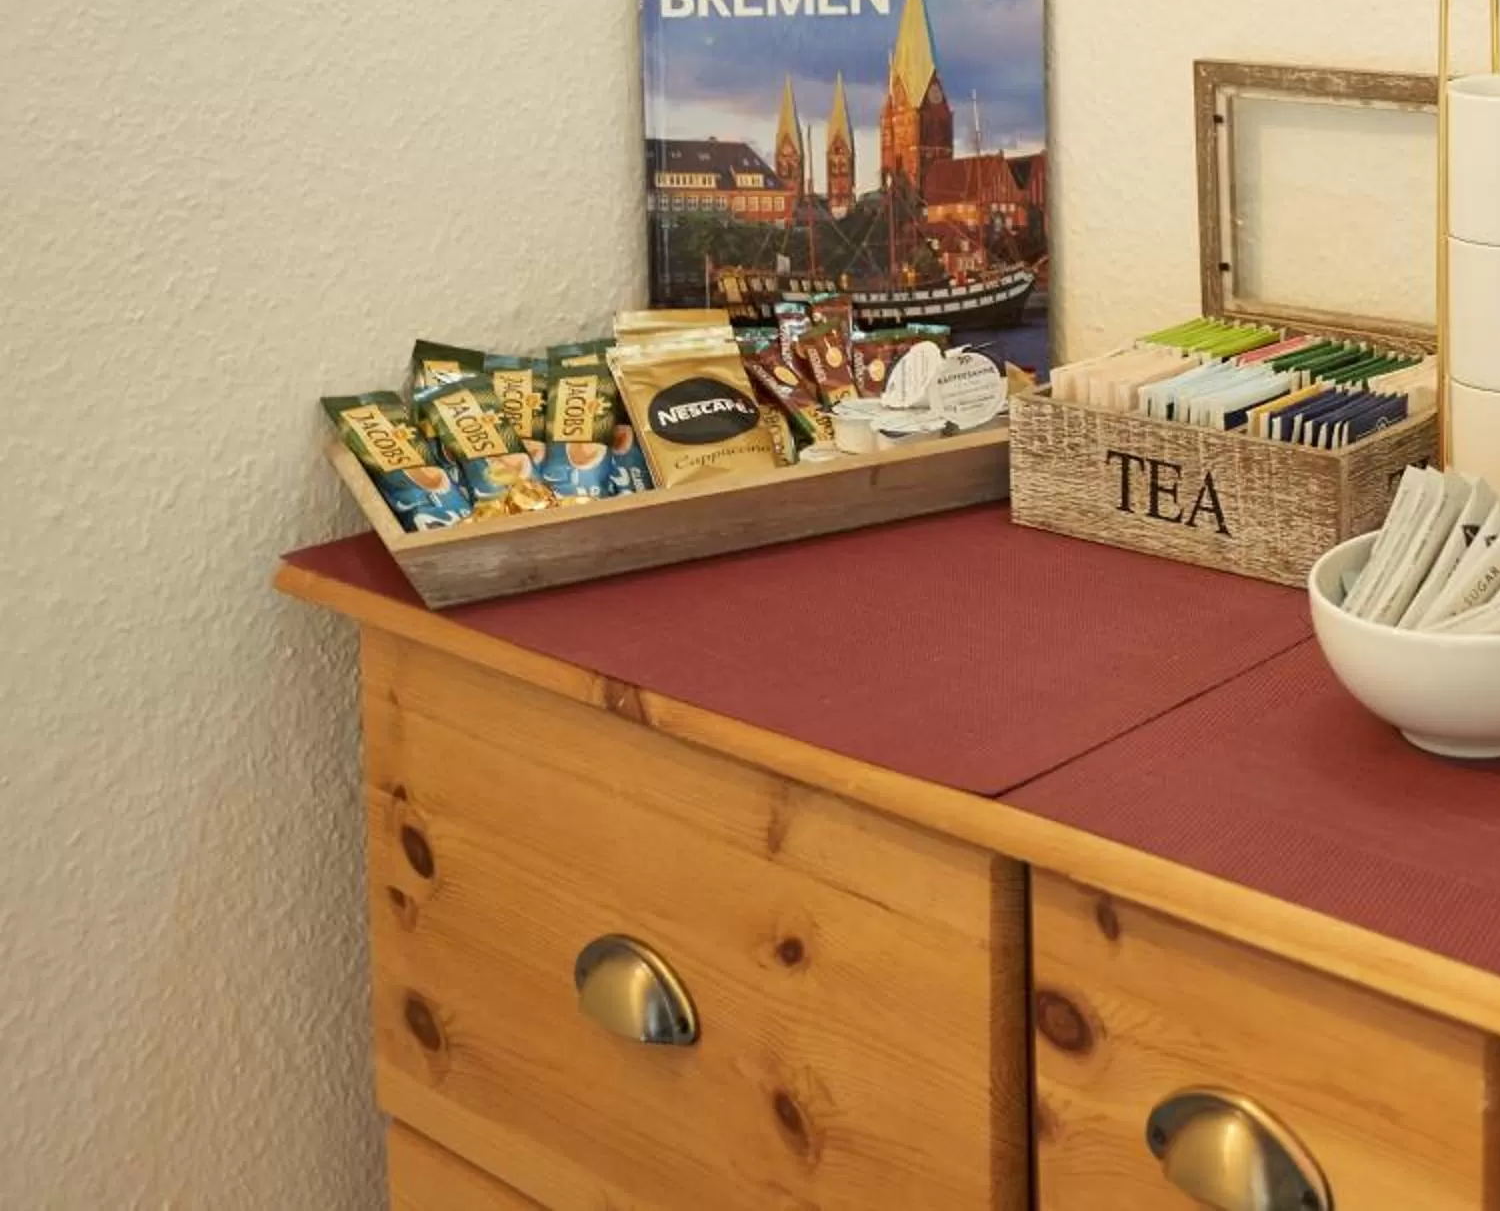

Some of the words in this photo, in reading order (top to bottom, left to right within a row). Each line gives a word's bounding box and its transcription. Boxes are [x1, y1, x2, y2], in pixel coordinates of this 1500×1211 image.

[442, 397, 496, 453] JACOBS
[562, 380, 589, 438] JACOBS
[349, 411, 412, 467] JACOBS
[1105, 449, 1233, 538] TEA
